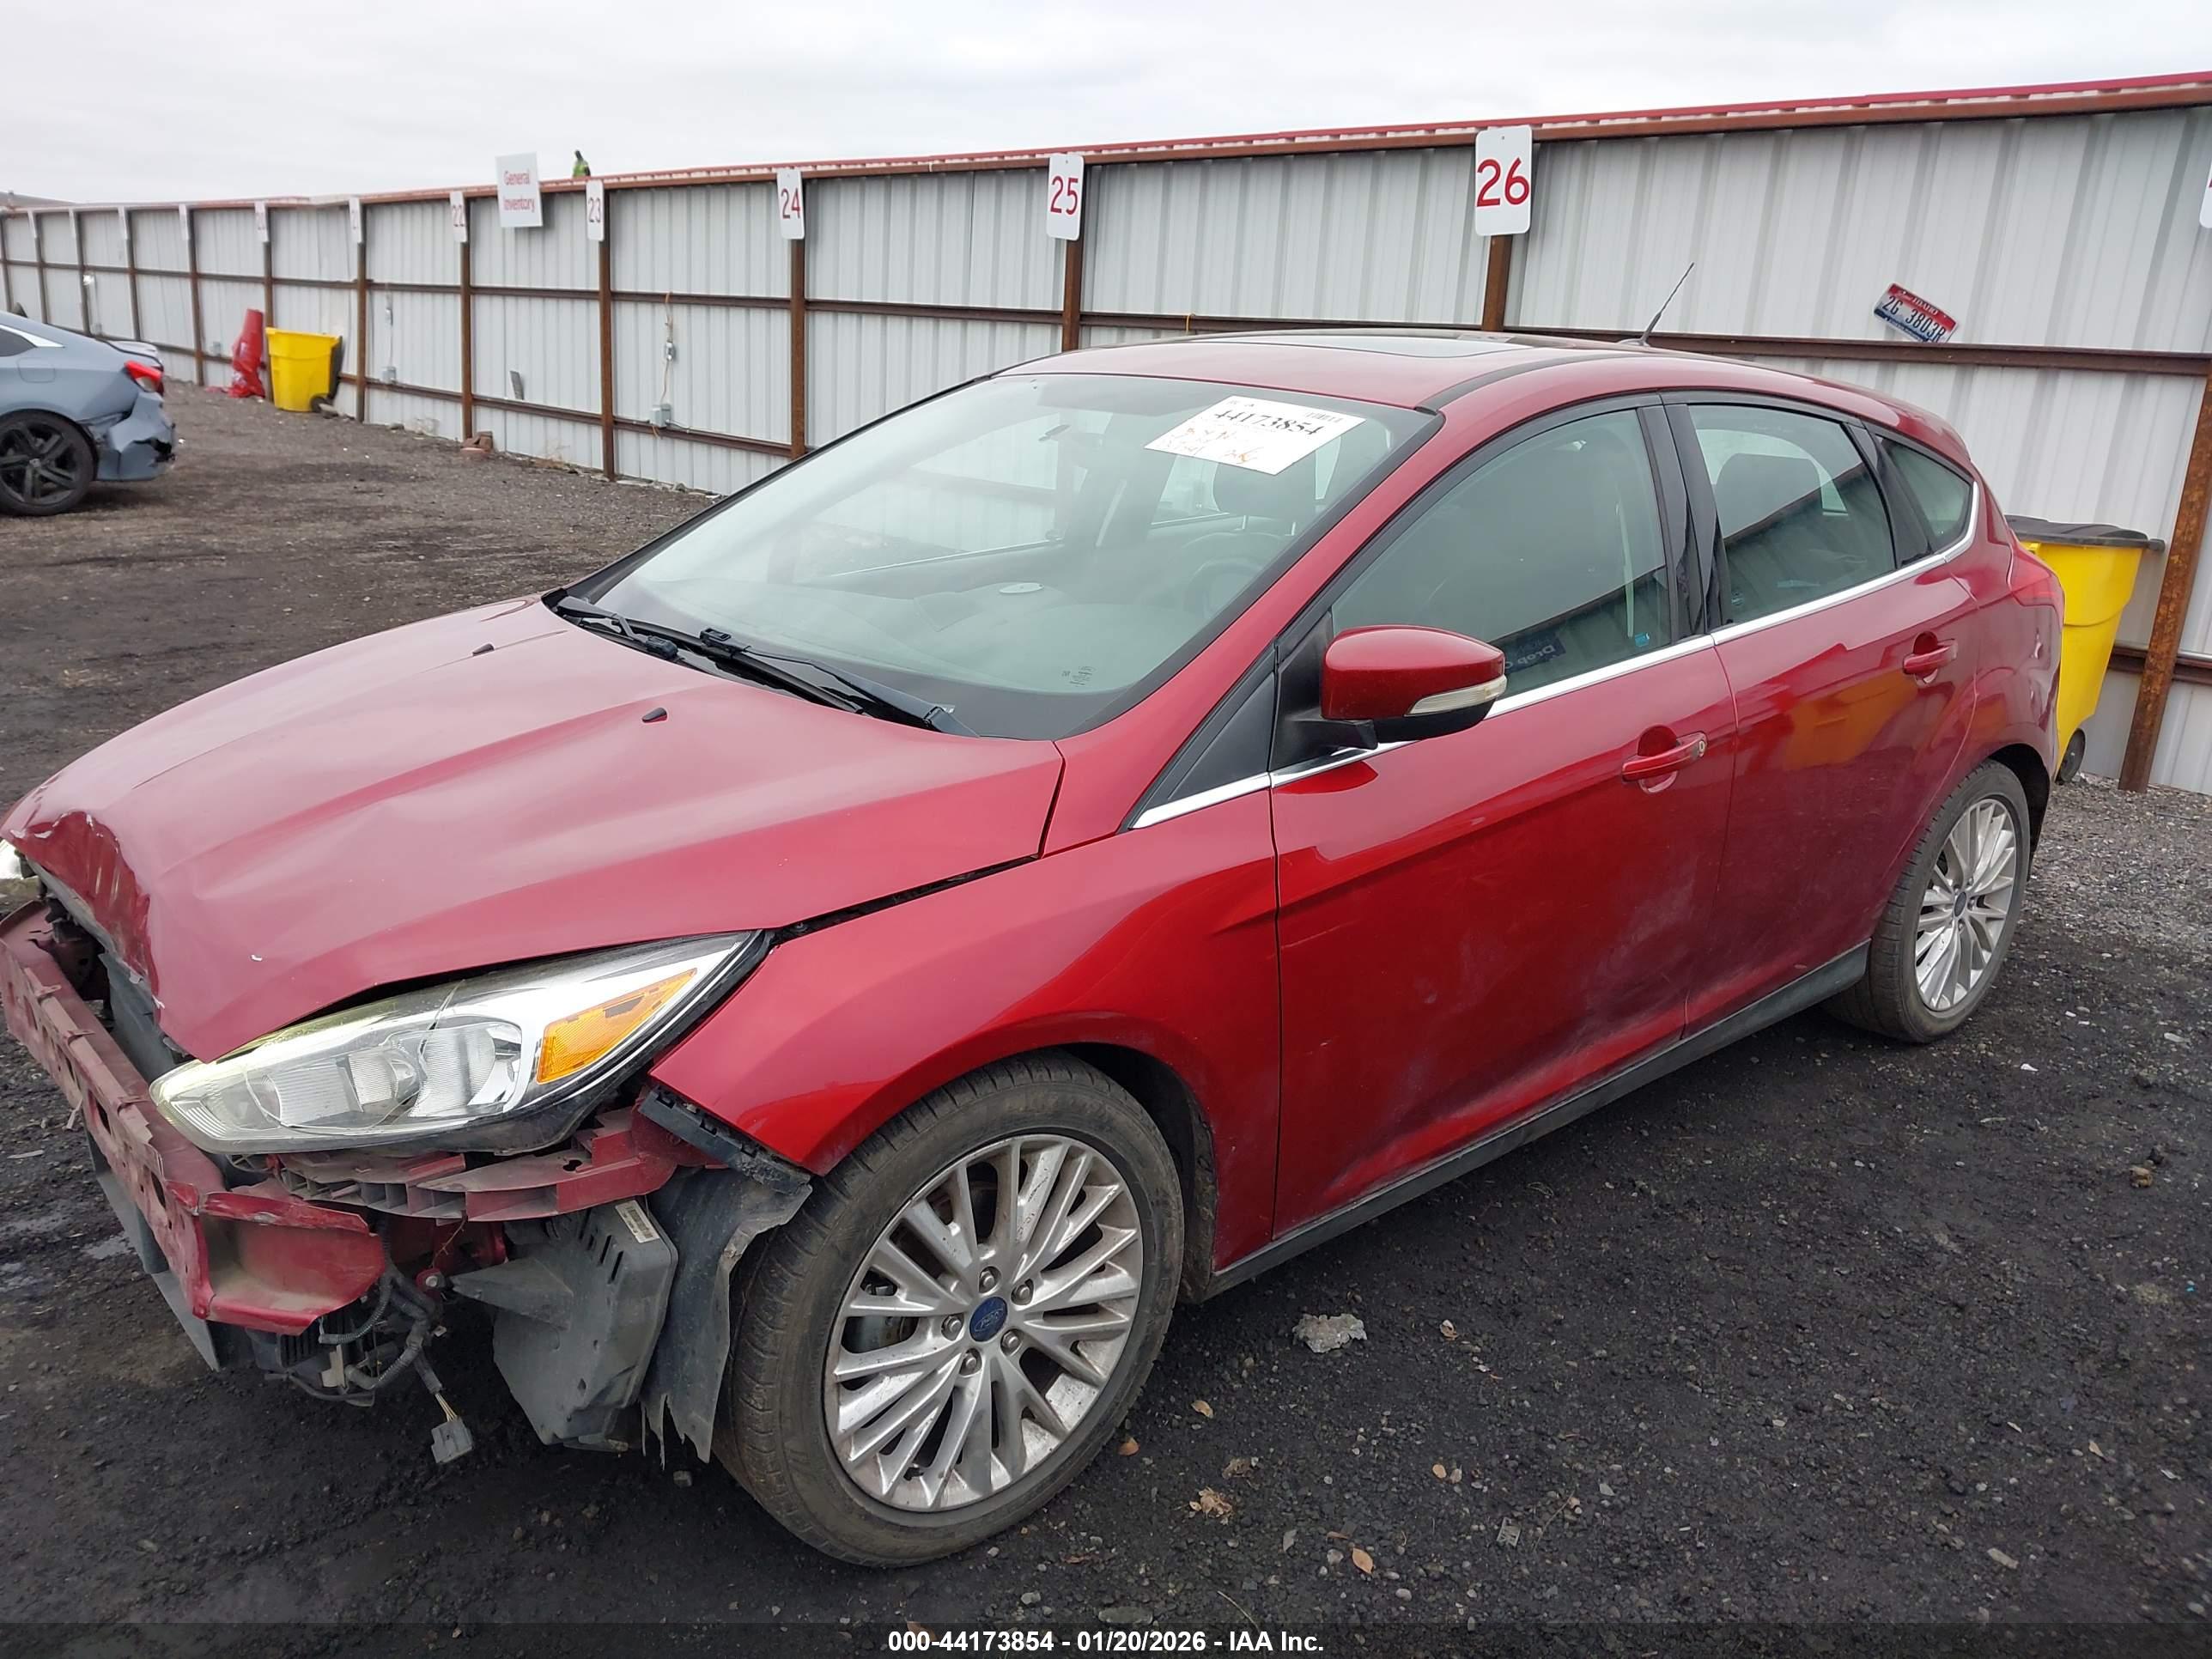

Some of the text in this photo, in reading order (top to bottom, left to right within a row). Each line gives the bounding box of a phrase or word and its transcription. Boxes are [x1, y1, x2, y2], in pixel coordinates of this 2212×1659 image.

[503, 169, 531, 185] General
[1477, 157, 1529, 207] 26
[502, 195, 536, 214] Inventory
[781, 188, 800, 219] 24
[1050, 176, 1079, 215] 25
[588, 197, 601, 223] 23
[1911, 296, 1939, 316] IDAHO
[1905, 308, 1946, 343] 3803R
[1214, 409, 1325, 435] 44173854
